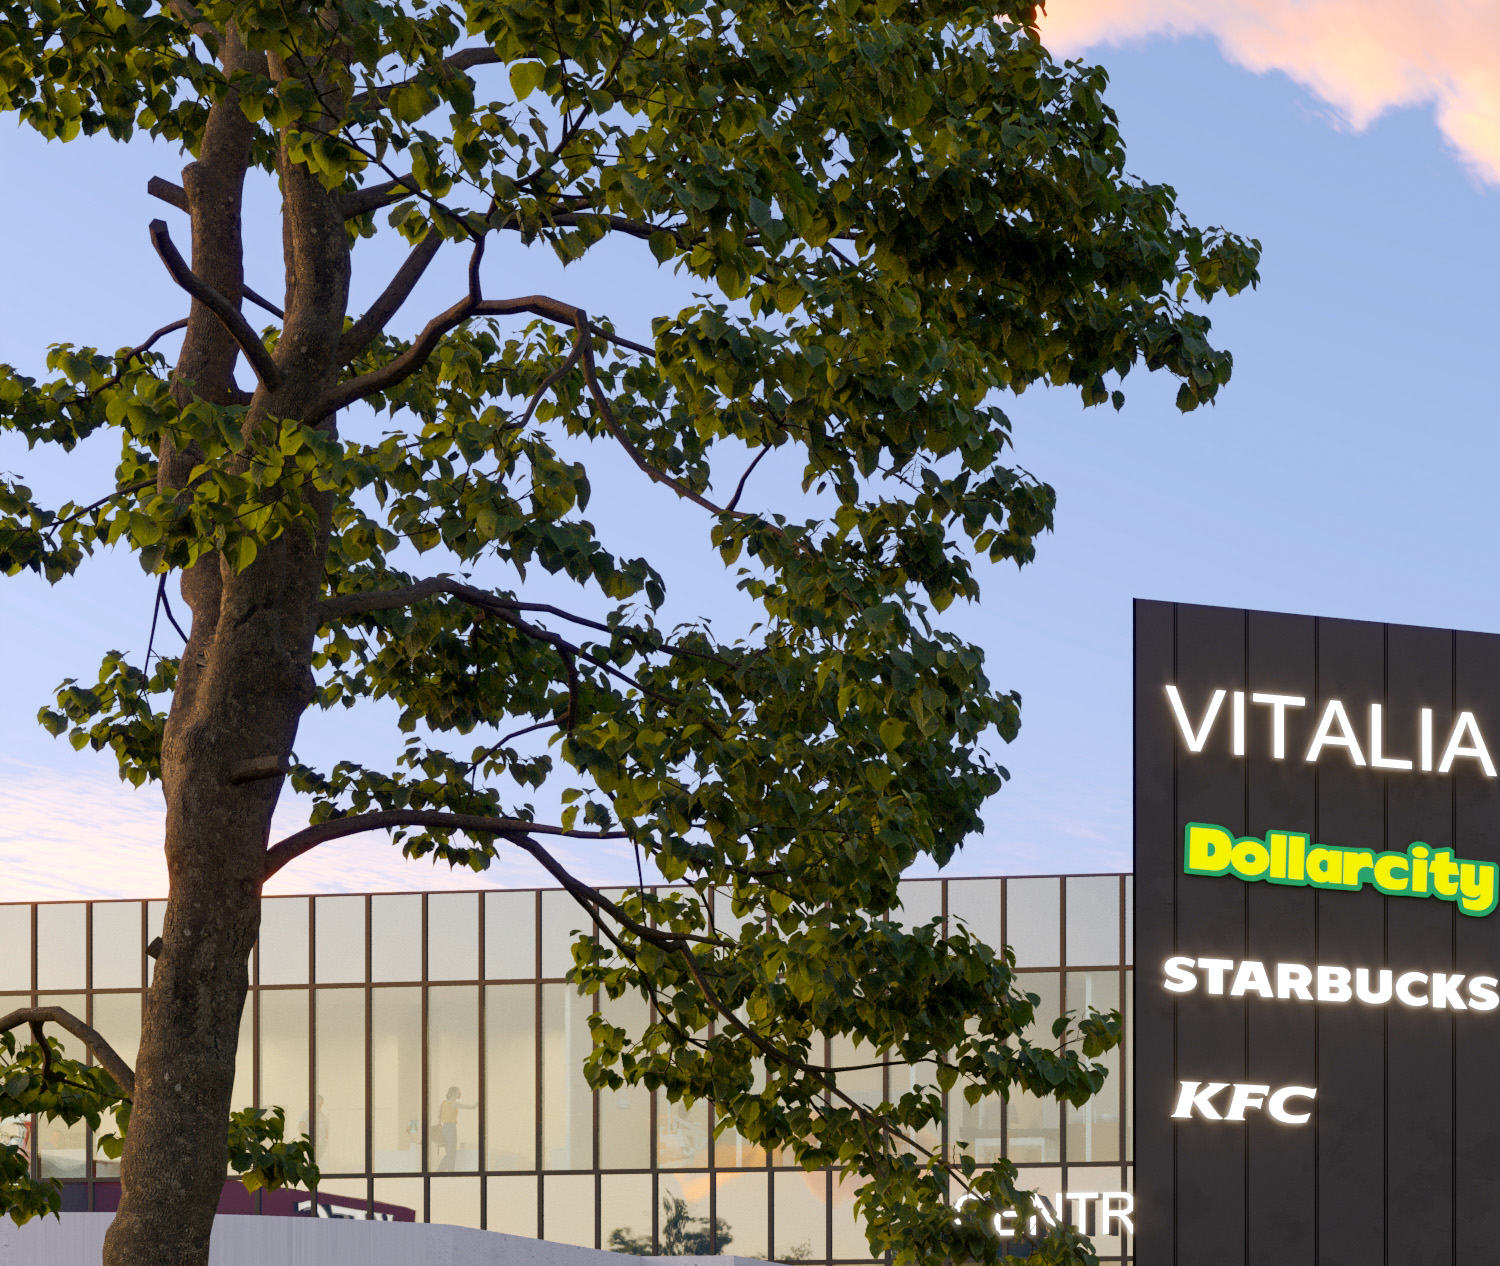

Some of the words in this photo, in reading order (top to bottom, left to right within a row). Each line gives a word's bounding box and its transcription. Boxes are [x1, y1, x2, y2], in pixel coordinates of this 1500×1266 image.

[1165, 685, 1498, 777] VITALIA
[1186, 824, 1498, 915] Dollarcity
[1162, 956, 1500, 1012] STARBUCKS
[1170, 1080, 1318, 1124] KFC
[954, 1192, 1134, 1236] ENTR
